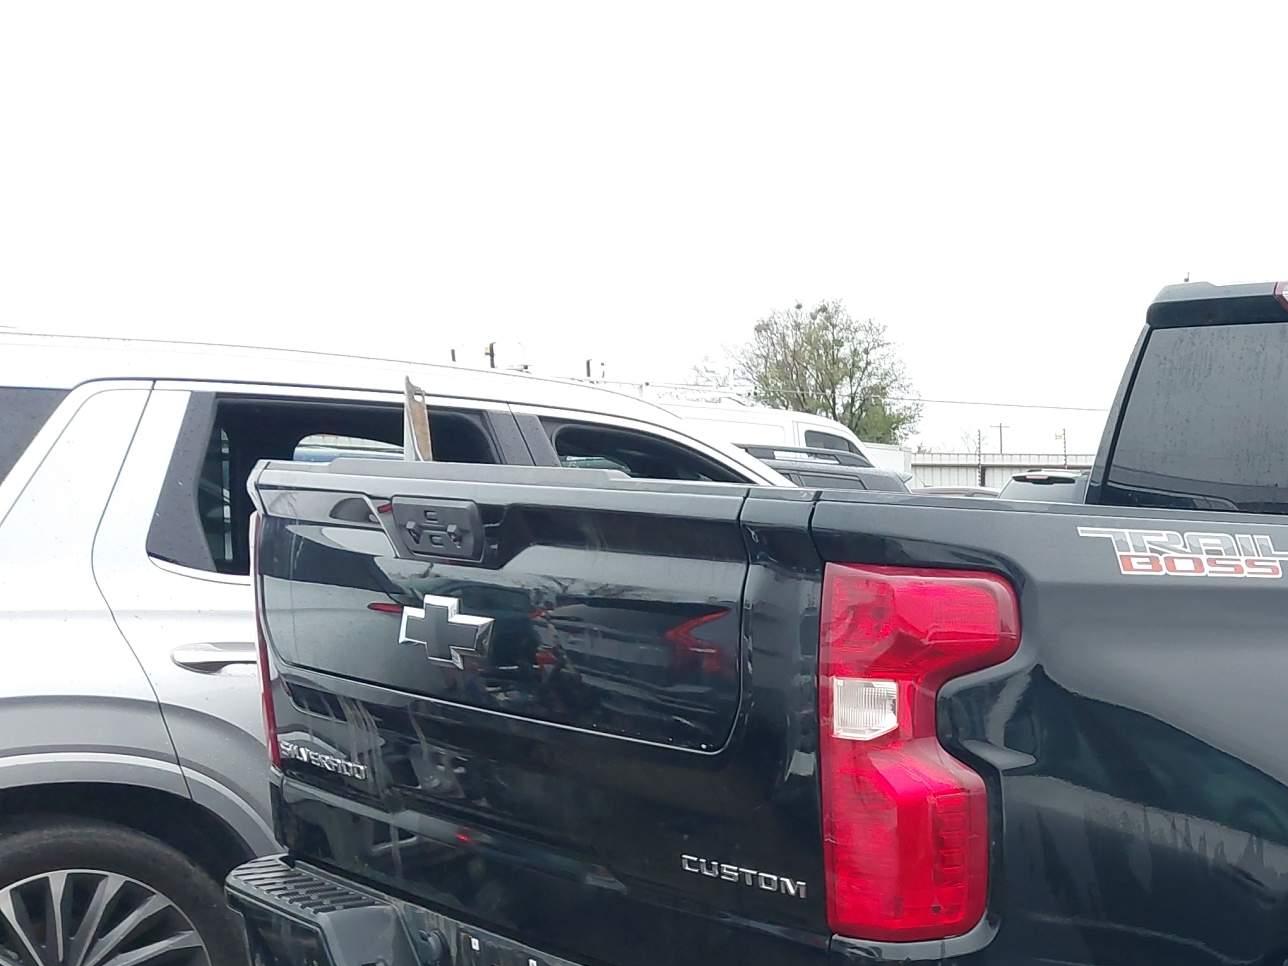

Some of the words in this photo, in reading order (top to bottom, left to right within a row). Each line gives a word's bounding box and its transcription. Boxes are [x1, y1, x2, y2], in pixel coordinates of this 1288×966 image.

[1119, 553, 1282, 578] BOSS
[279, 740, 368, 780] SILVERADO
[681, 854, 807, 899] CUSTOM
